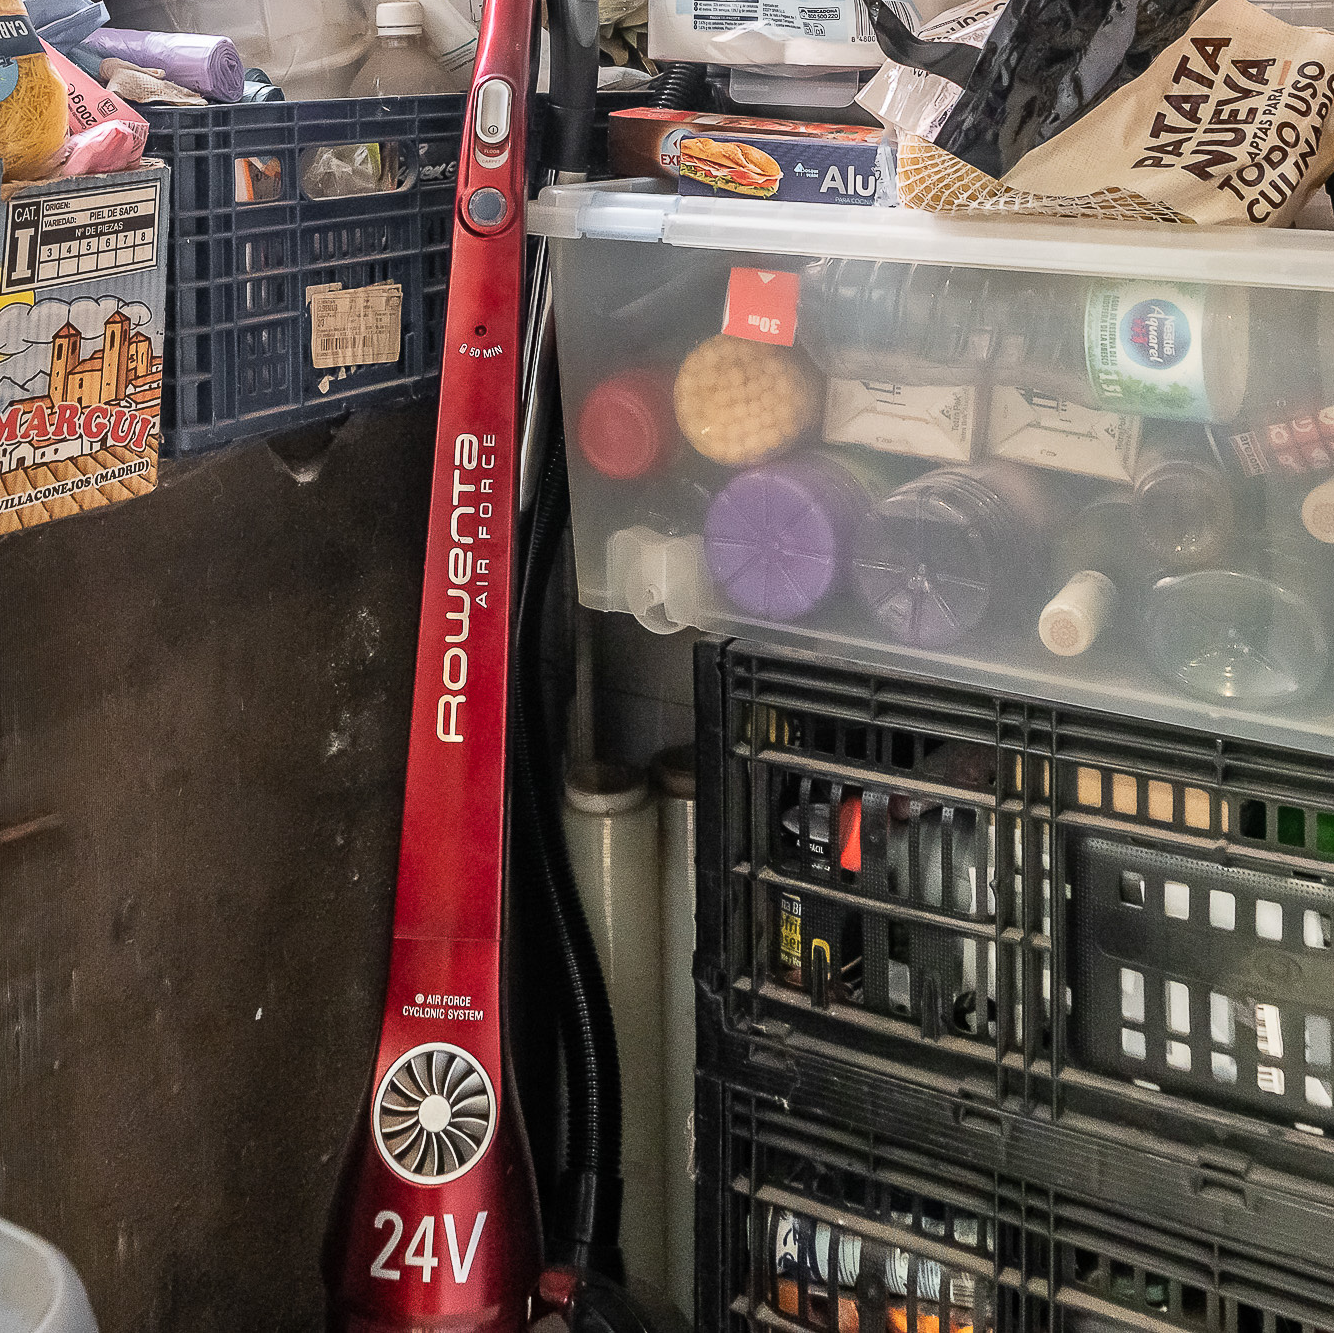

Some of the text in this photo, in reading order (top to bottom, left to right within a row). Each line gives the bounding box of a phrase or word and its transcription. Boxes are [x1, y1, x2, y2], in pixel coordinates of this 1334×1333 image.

[1131, 37, 1232, 170] PATATA
[1181, 58, 1277, 181] NUEVA
[1217, 61, 1326, 201] TODO USO
[1246, 87, 1286, 163] APTAS PARA
[14, 206, 38, 222] CAT.
[44, 205, 138, 228] VARIEDAD: PIEL DE SAPO
[45, 202, 70, 212] ORIGEN:
[86, 226, 96, 235] DE
[97, 222, 123, 233] PIEZAS
[47, 232, 146, 257] 3 4 5 6 7 8
[748, 314, 781, 334] 30m
[1146, 305, 1168, 363] Aquarel
[1163, 316, 1175, 356] Nestlé
[469, 344, 503, 358] 50 MIN
[94, 458, 151, 486] (MADRID)
[475, 433, 496, 608] AIR FORCE
[436, 432, 479, 743] Rowenta
[402, 1005, 484, 1021] CYCLONIC SYSTEM
[426, 994, 471, 1007] AIR FORCE
[370, 1210, 488, 1284] 24V
